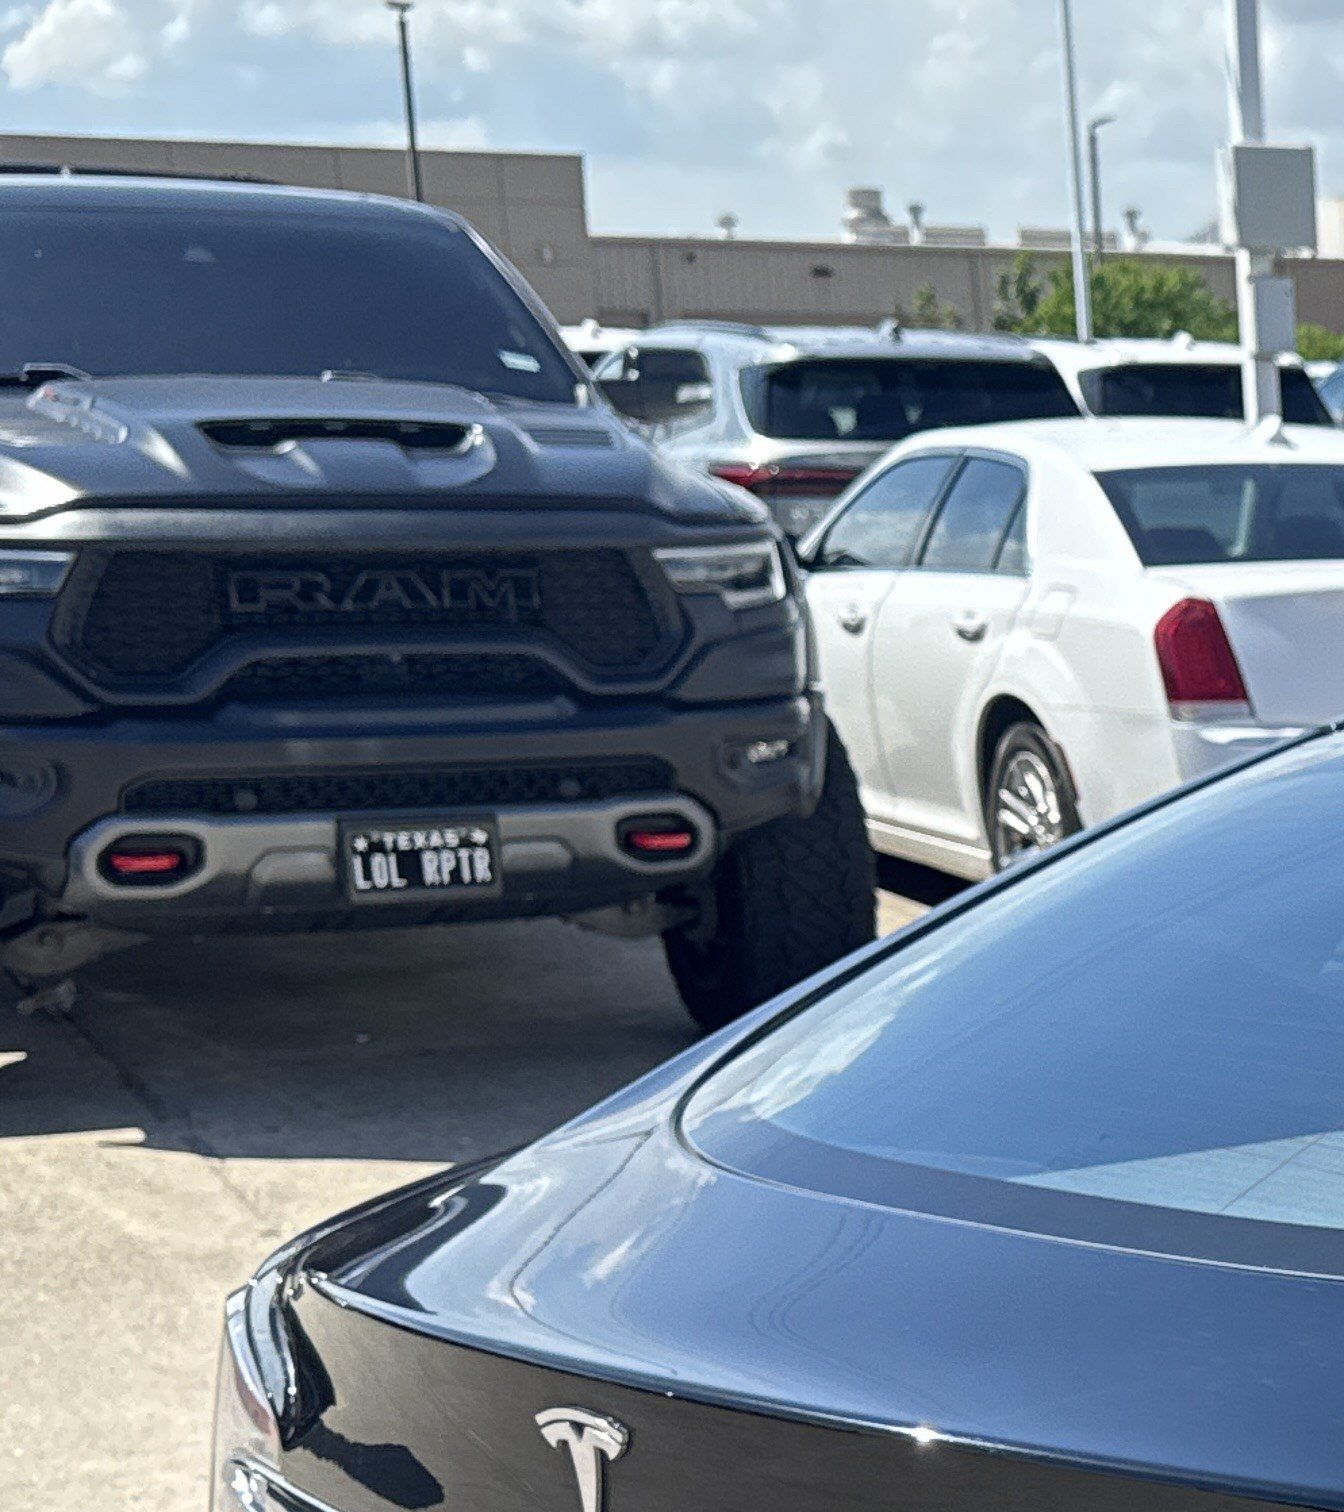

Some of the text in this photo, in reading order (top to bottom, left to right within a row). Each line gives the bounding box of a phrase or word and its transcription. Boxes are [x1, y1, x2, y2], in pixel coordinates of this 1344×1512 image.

[229, 569, 541, 613] RAM
[382, 828, 460, 851] TEXAS
[352, 846, 493, 890] LOL RPTR
